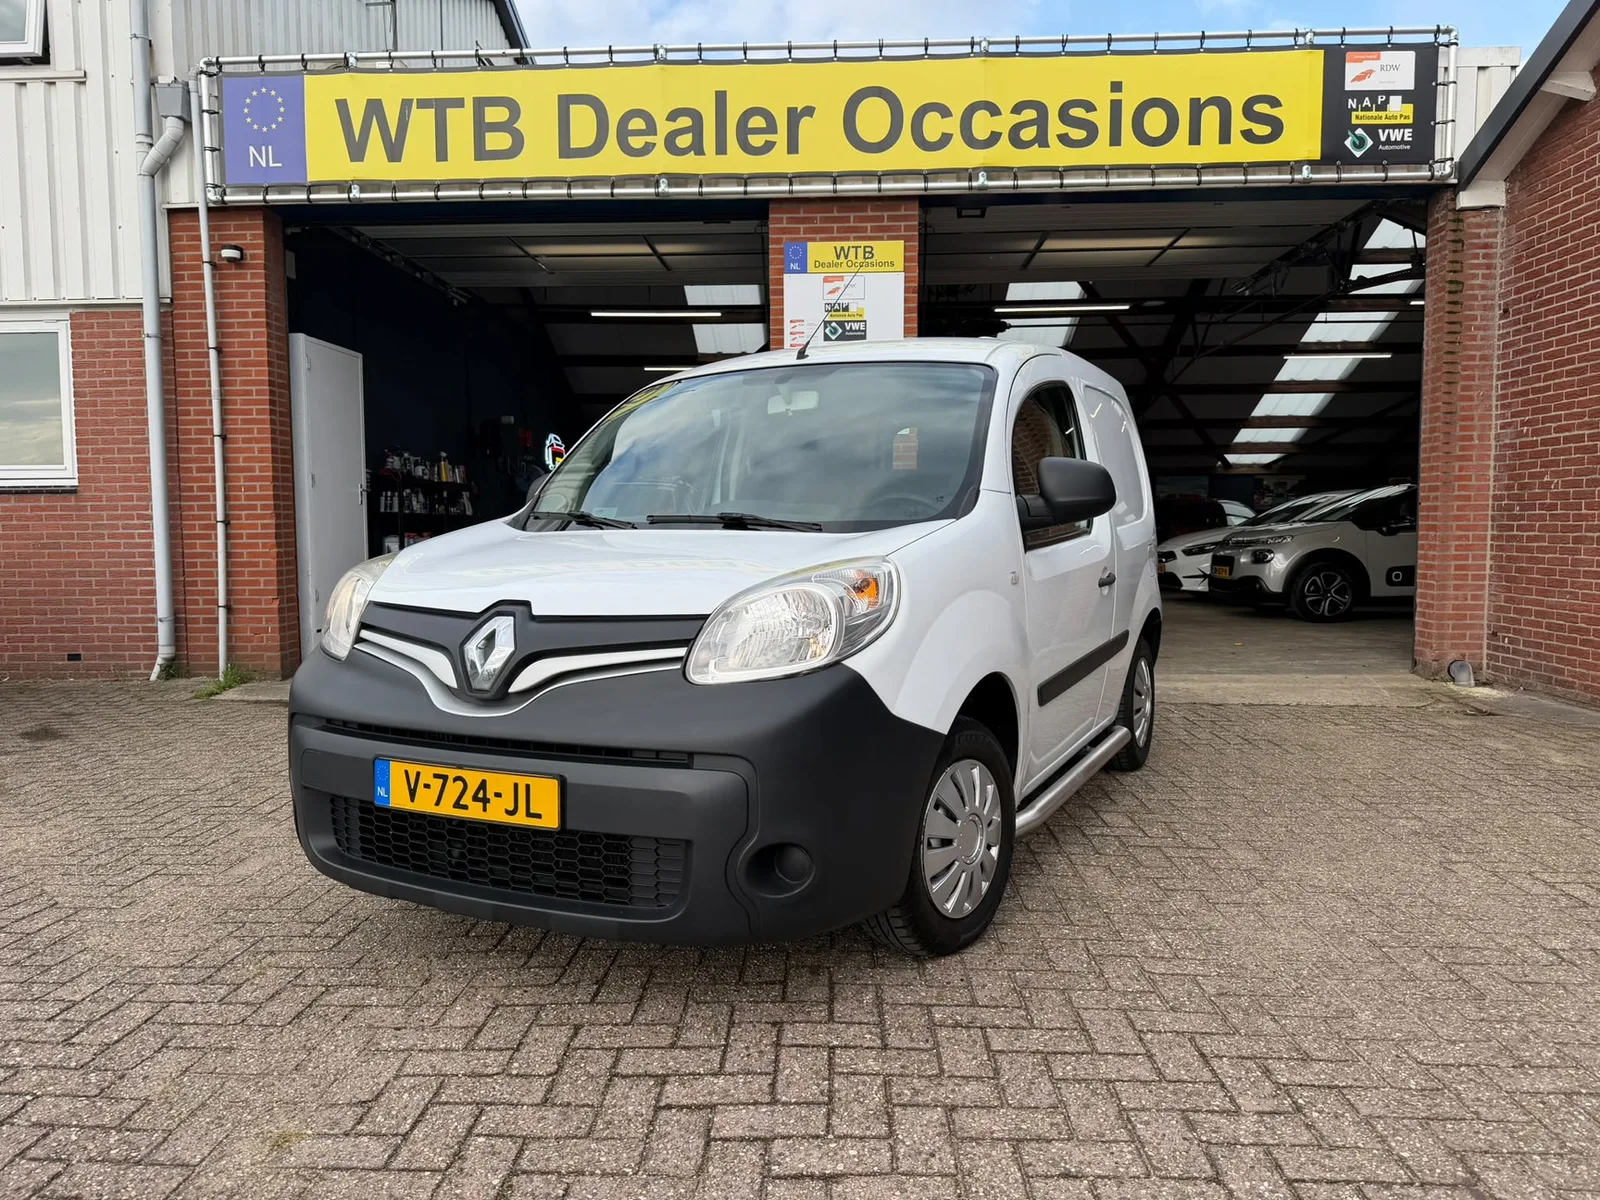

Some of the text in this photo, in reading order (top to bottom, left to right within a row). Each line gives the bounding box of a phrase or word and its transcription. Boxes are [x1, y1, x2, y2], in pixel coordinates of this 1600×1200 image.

[1379, 64, 1401, 72] RDW
[334, 80, 1286, 164] WTB Dealer Occasions
[1378, 128, 1413, 142] VWE
[247, 144, 283, 168] NL
[833, 245, 874, 260] WTB
[790, 262, 801, 270] NL
[814, 259, 895, 268] Dealer Occasions
[844, 321, 866, 331] VWE
[377, 786, 388, 798] NL
[404, 769, 543, 819] V-724-JL
